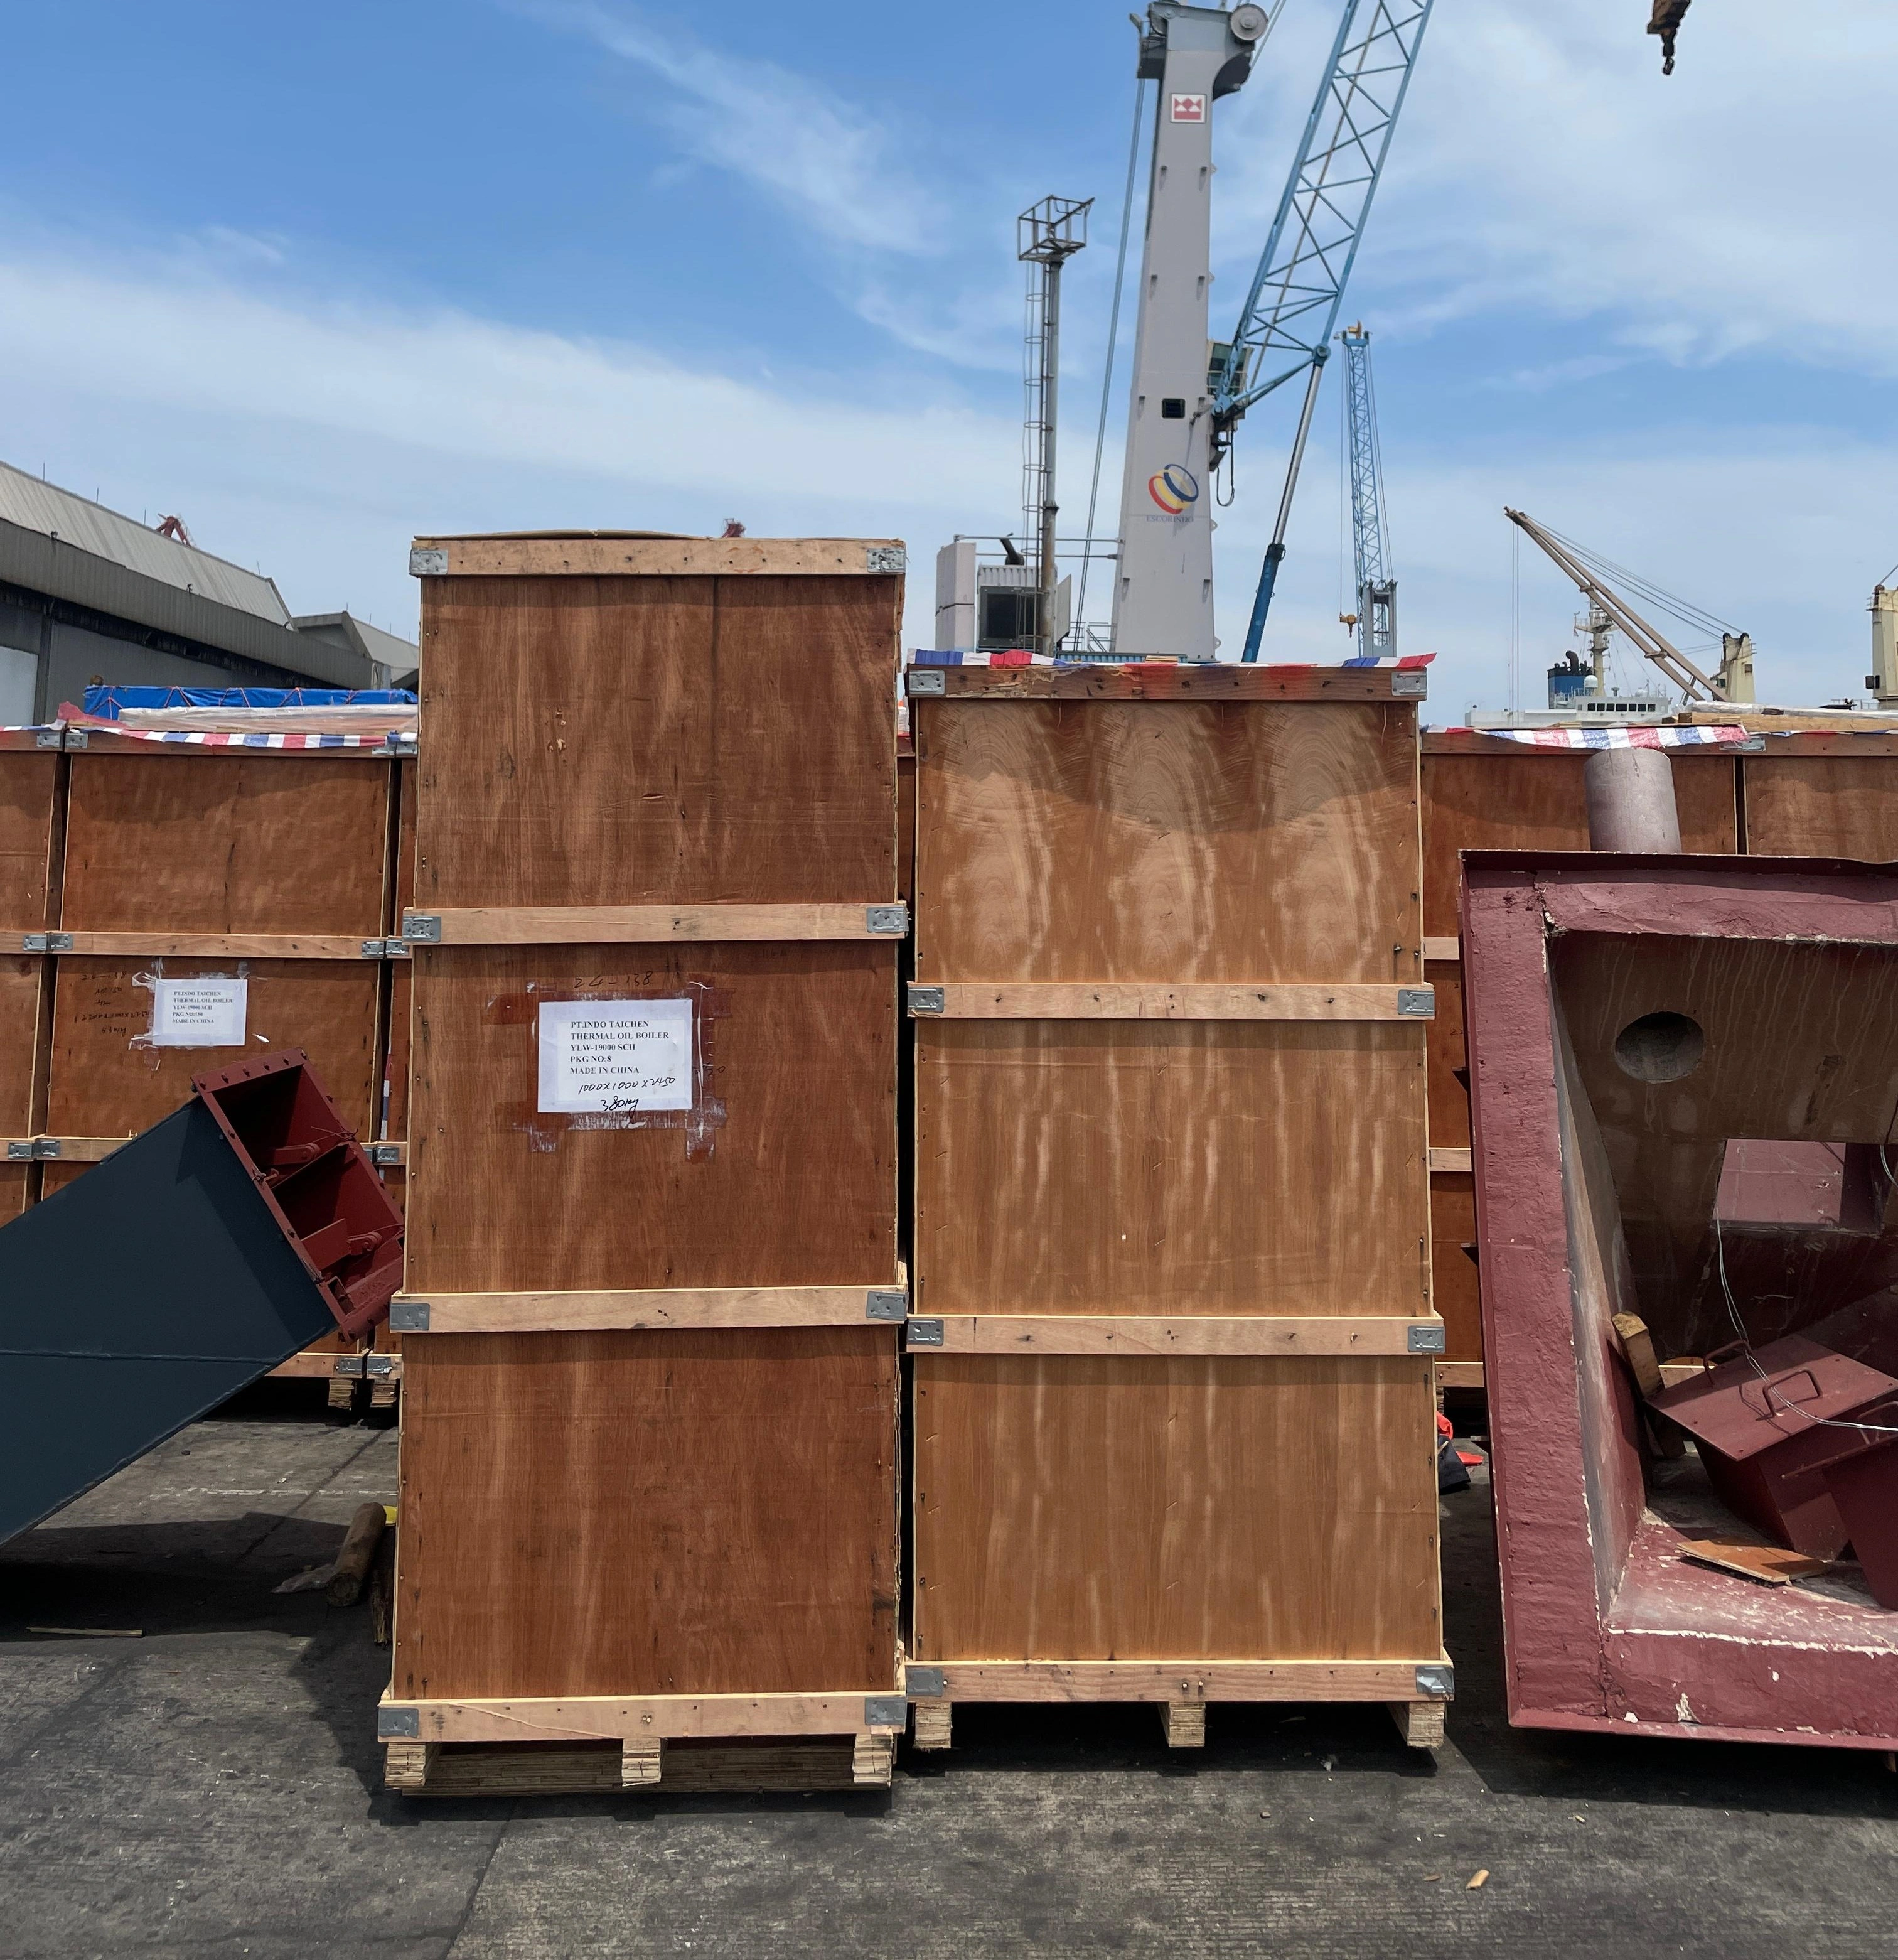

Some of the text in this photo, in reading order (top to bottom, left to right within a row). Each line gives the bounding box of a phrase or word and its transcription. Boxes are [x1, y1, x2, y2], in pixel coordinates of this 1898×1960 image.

[609, 1020, 649, 1028] TAICHEN
[571, 1031, 670, 1040] THERMAL OIL BOILER
[571, 1043, 616, 1052] YLW-19000
[570, 1066, 640, 1075] MADE IN CHINA
